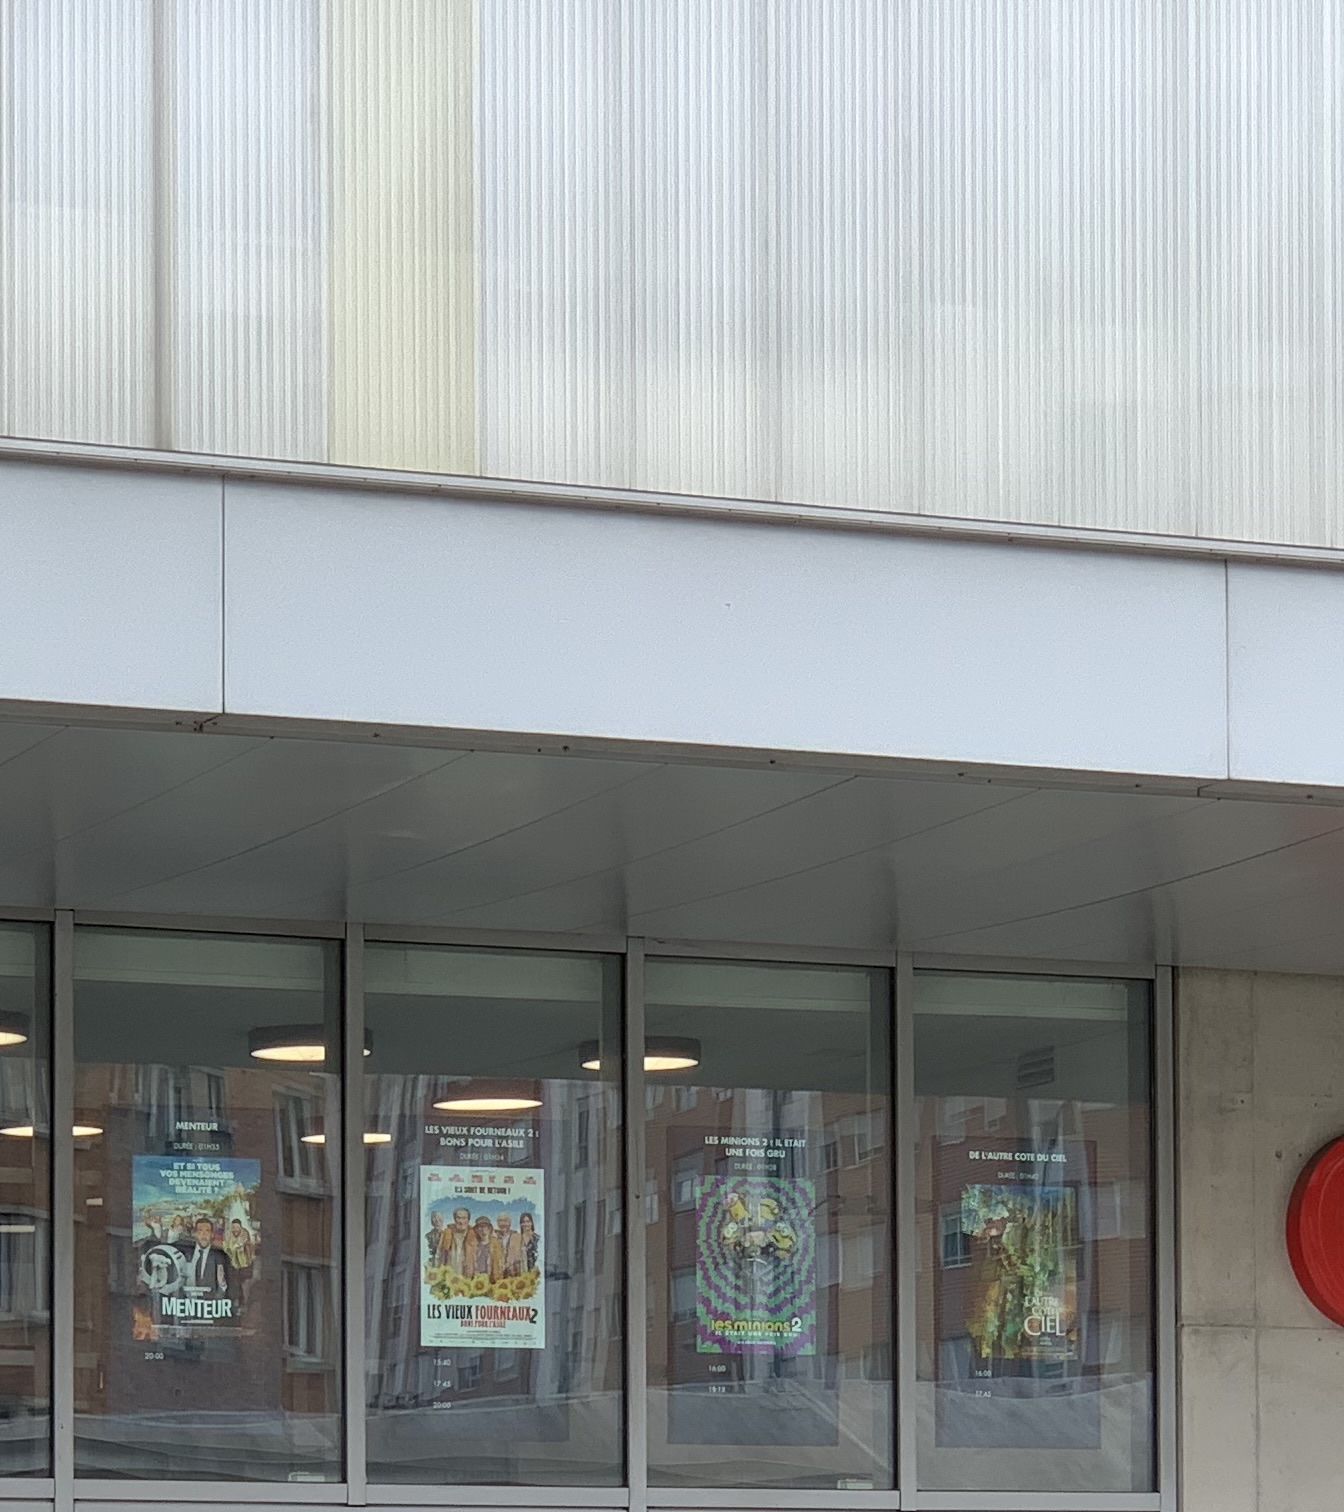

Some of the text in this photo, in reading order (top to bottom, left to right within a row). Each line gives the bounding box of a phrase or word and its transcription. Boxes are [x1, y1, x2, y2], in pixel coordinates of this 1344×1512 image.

[176, 1121, 218, 1131] MENTEUR
[425, 1125, 439, 1134] LES
[441, 1125, 468, 1135] VIEUX
[470, 1126, 525, 1137] FOURNEAUX
[527, 1129, 534, 1137] 2
[440, 1137, 524, 1149] BONS POUR L'ASILE
[704, 1136, 719, 1145] LES
[720, 1136, 760, 1146] MINIONS
[762, 1138, 768, 1146] 2
[775, 1138, 783, 1147] IL
[784, 1139, 807, 1148] ETAIT
[725, 1148, 786, 1159] UNE FOIS GRU
[969, 1151, 1067, 1162] DE L'AUTRE COTE DU CIEL
[173, 1162, 185, 1170] ET
[196, 1163, 221, 1171] TOUS
[160, 1169, 234, 1179] VOS MENSONGES
[161, 1296, 233, 1319] MENTEUR
[427, 1304, 441, 1319] LES
[445, 1304, 473, 1320] VIEUX
[475, 1305, 531, 1321] FOURNEAUX
[1023, 1309, 1066, 1336] CIEL
